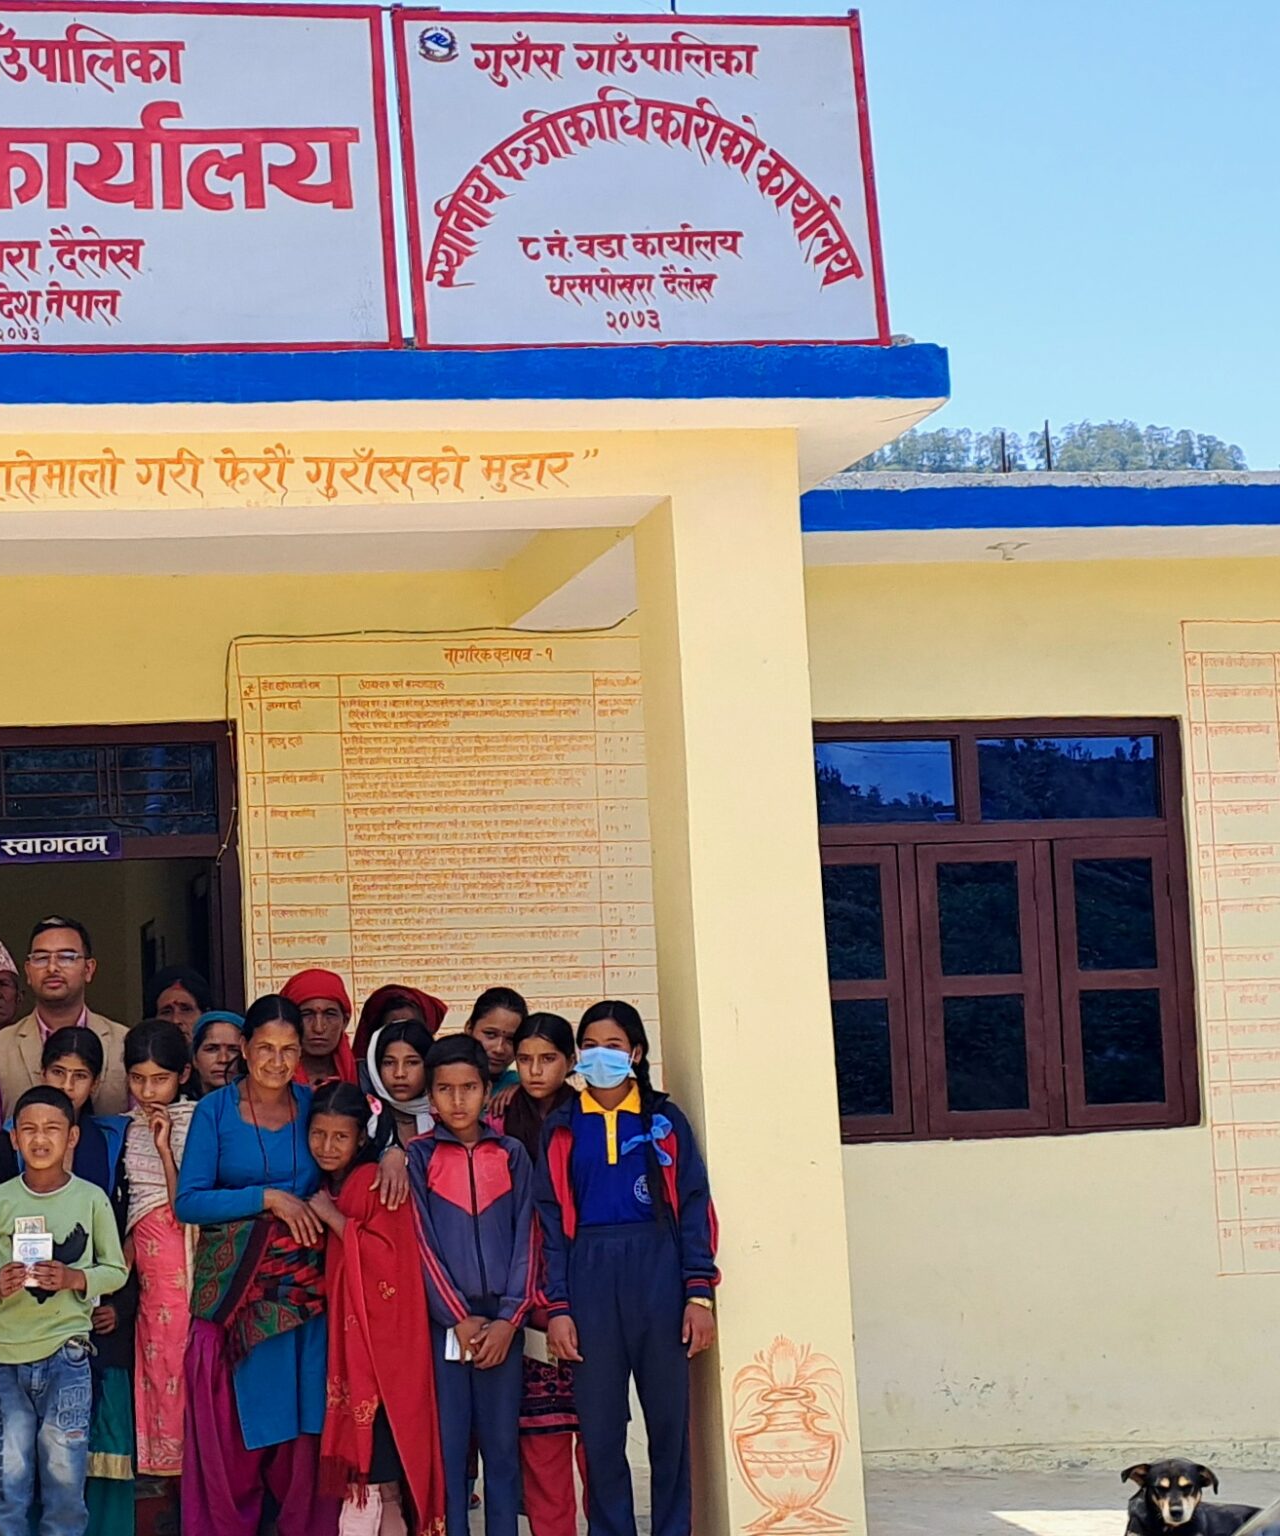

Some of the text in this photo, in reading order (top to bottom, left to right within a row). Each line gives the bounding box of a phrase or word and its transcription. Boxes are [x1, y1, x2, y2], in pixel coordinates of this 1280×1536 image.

[470, 31, 759, 87] गुराँस गाउँपालिका
[425, 165, 517, 288] स्थानीय
[757, 148, 864, 292] कार्यालय
[630, 223, 744, 262] कार्यालय
[659, 264, 718, 304] दैलेख
[606, 309, 662, 335] २०७३
[135, 446, 205, 499] गरी
[303, 445, 470, 501] गुराँसको
[0, 835, 110, 856] स्वागतम्
